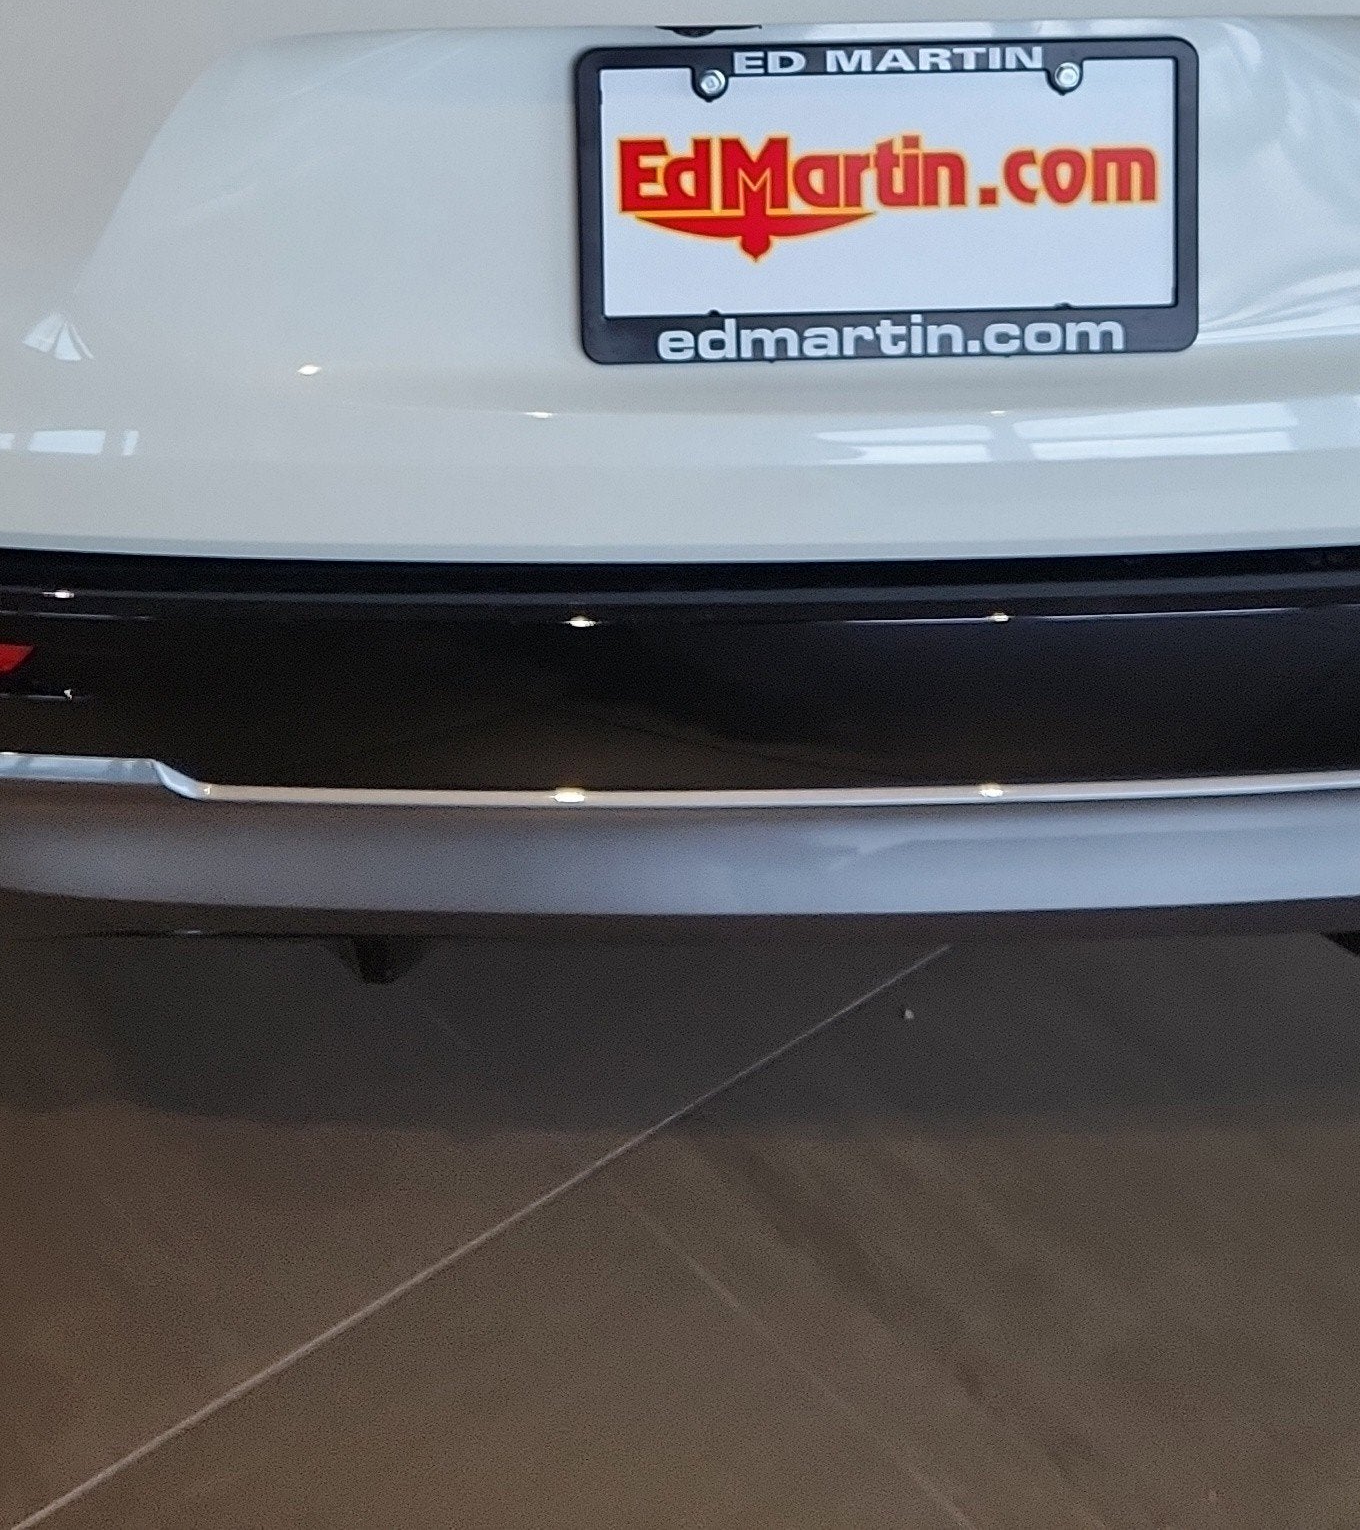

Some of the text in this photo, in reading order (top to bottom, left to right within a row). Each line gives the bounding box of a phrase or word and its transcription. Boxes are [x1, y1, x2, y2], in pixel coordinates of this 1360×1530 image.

[733, 45, 1043, 74] ED MARTIN
[617, 134, 1159, 261] EdMartin.com
[657, 313, 1126, 363] edmartin.com
